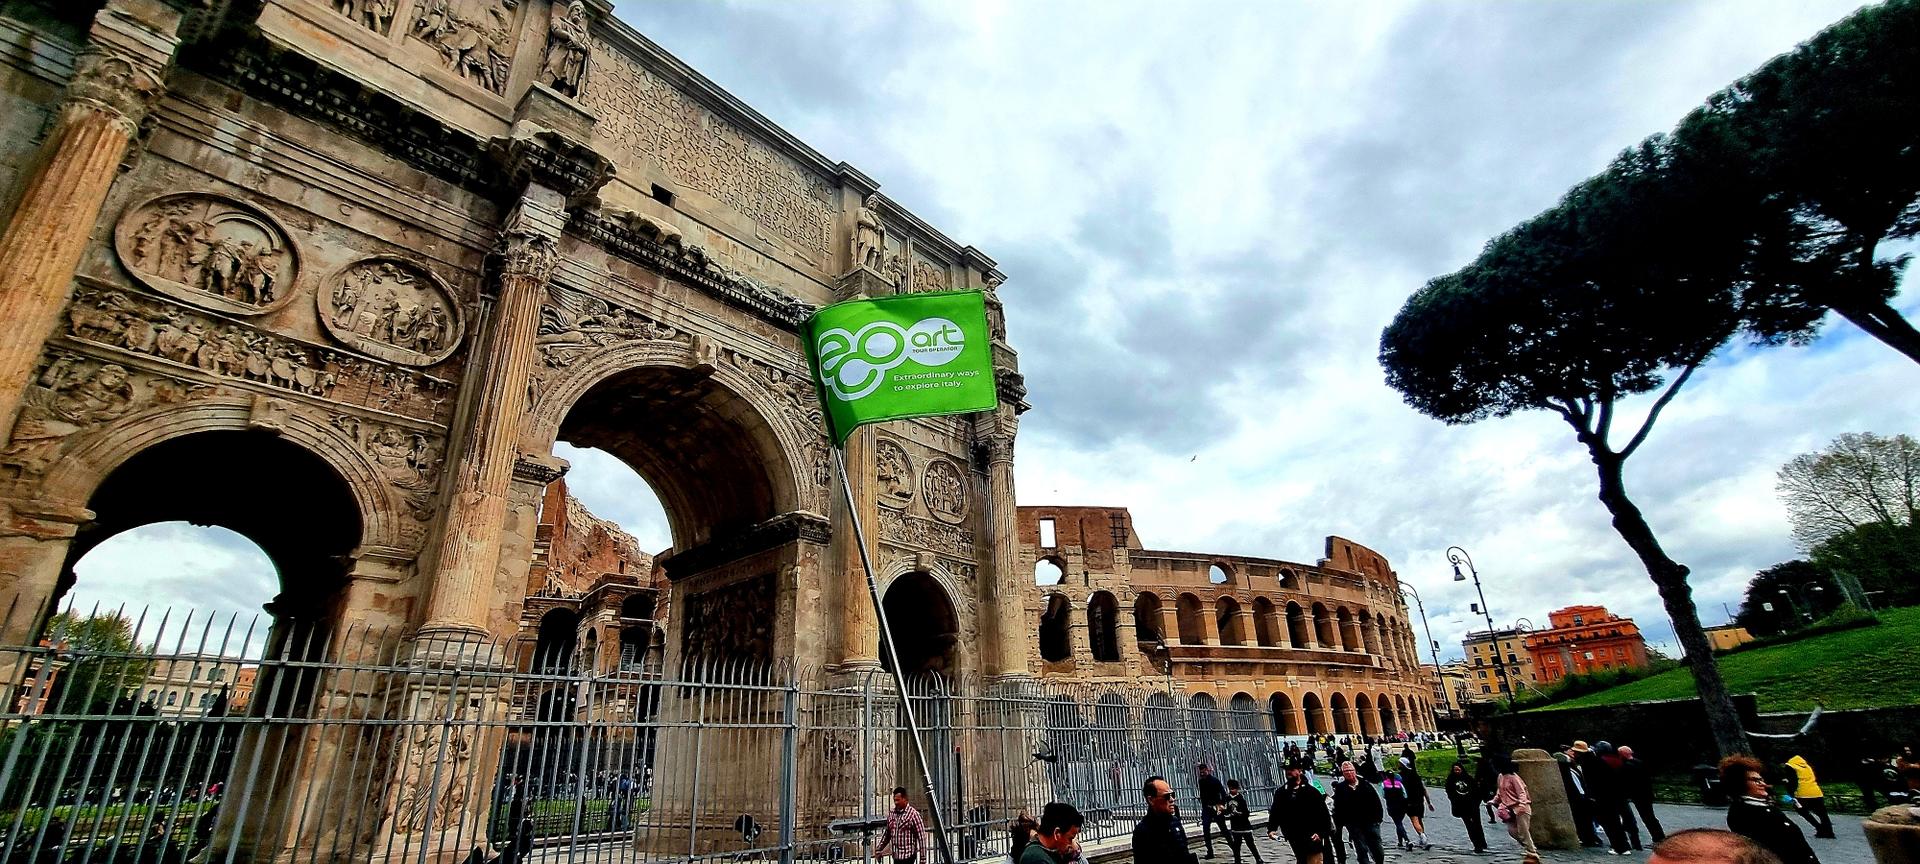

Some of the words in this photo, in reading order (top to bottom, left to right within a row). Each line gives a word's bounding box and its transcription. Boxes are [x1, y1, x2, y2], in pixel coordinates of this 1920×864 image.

[910, 324, 965, 348] art
[893, 370, 955, 382] Extraordinary
[956, 369, 980, 378] ways
[893, 384, 904, 392] to
[904, 382, 940, 391] explore
[941, 380, 964, 390] Italy.
